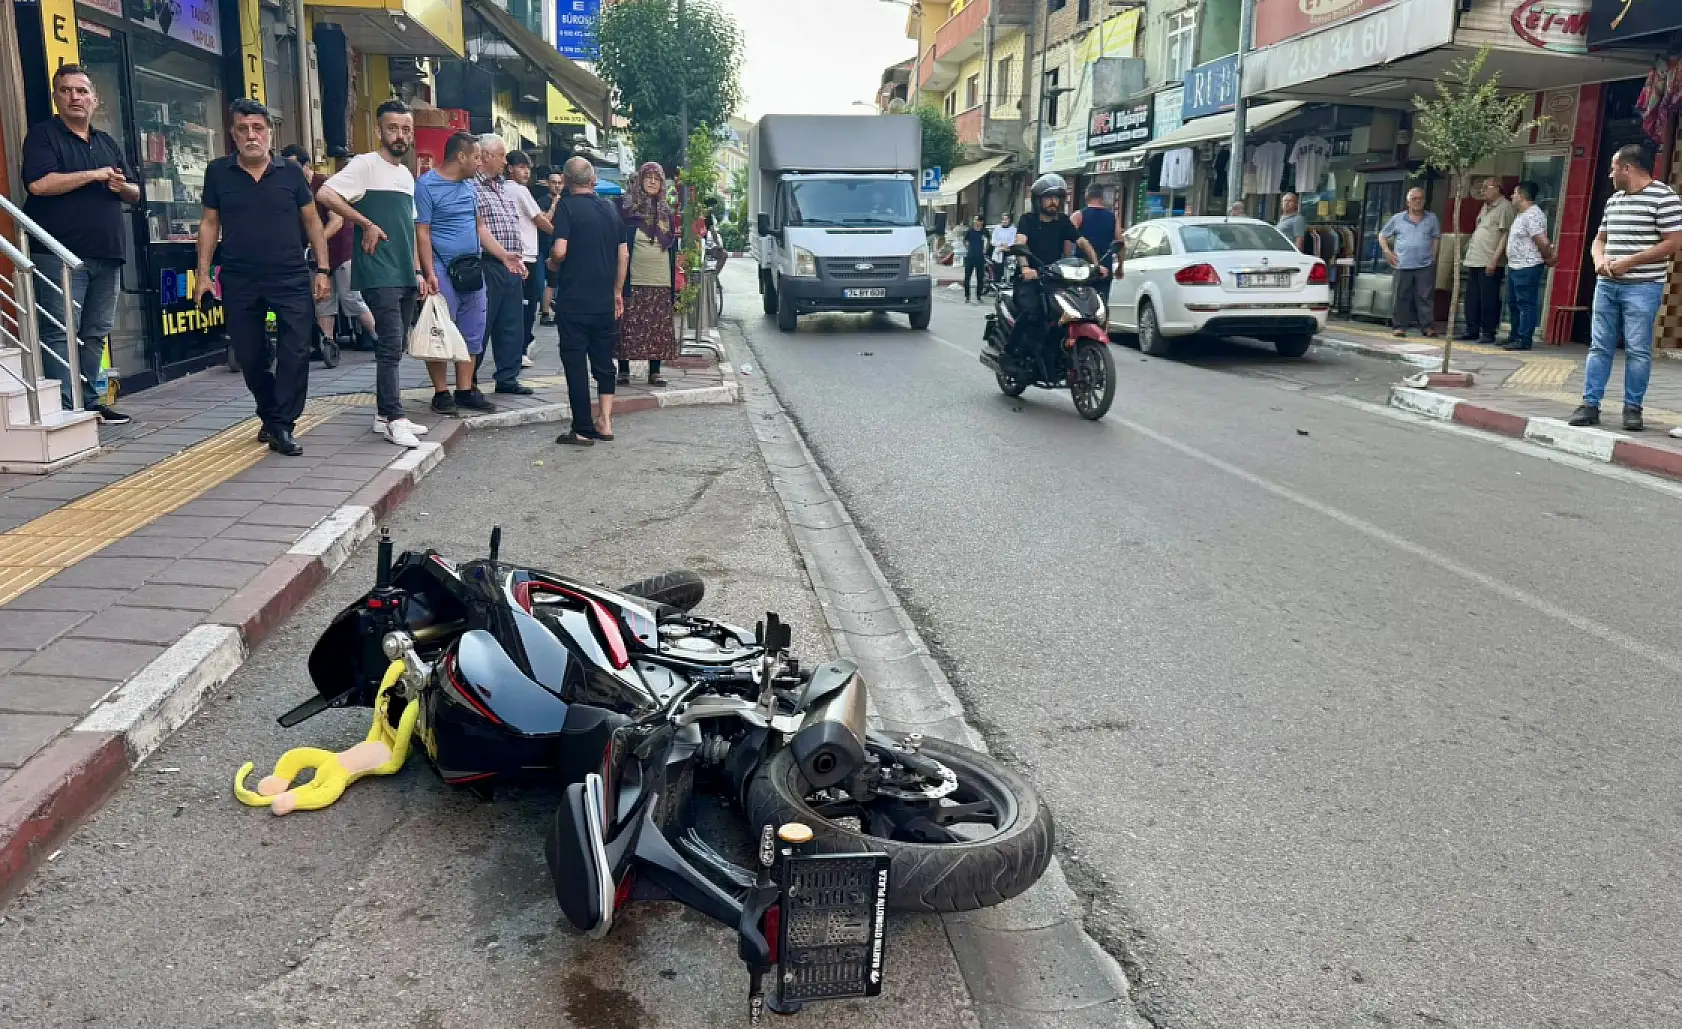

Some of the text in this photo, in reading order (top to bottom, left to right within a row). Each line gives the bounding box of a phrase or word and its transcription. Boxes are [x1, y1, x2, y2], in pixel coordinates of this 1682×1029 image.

[1287, 17, 1388, 79] 233 34 60
[922, 168, 935, 187] P
[878, 869, 888, 897] PLAZA
